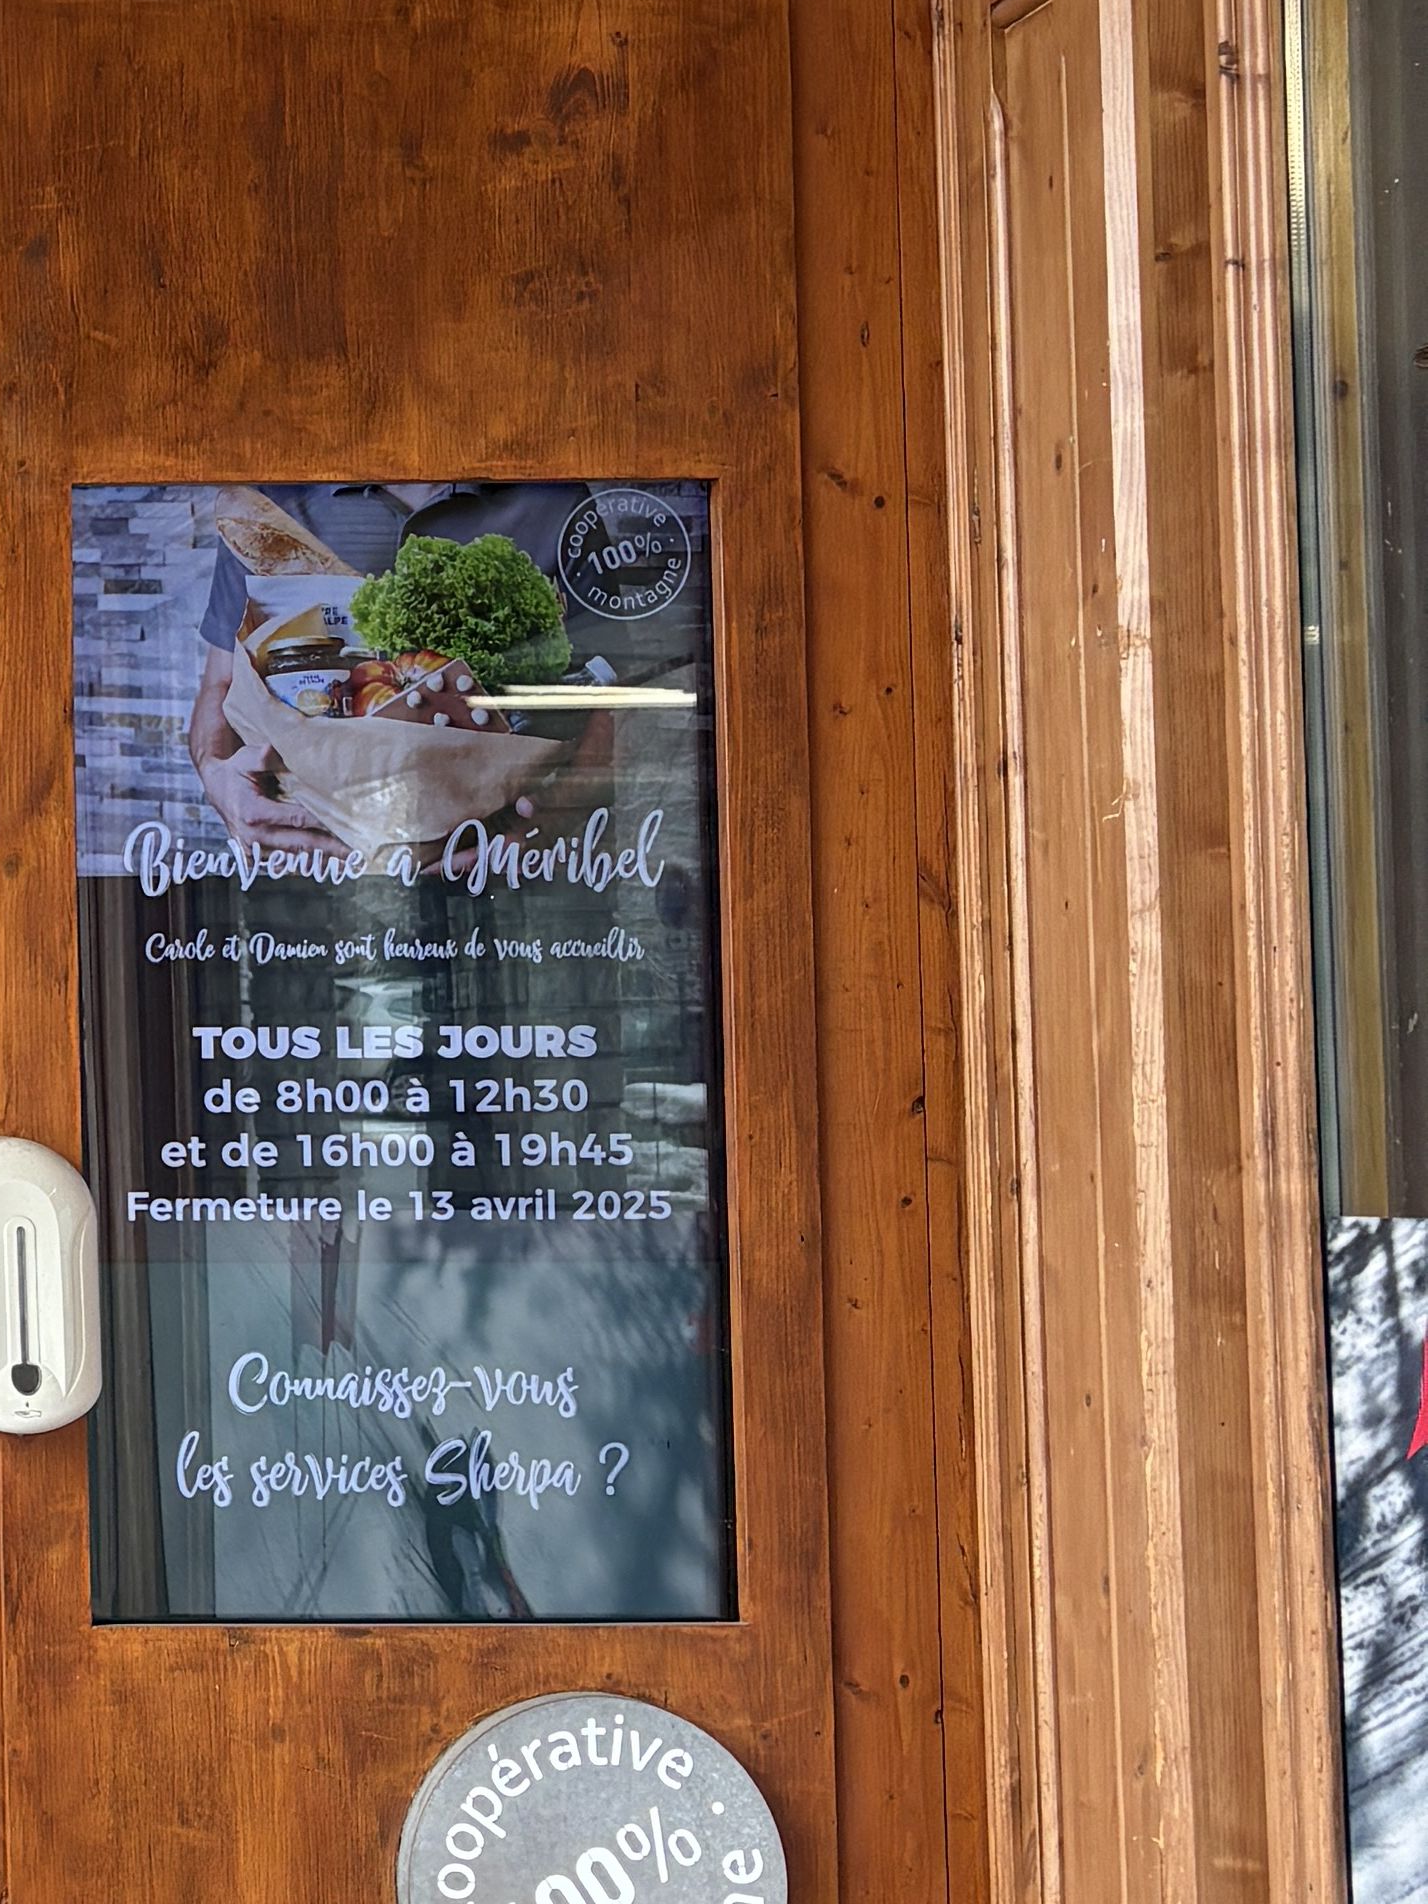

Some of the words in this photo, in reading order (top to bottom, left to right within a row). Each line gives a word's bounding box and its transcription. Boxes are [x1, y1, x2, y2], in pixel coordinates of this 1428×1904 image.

[587, 531, 663, 575] 100%
[587, 557, 682, 611] montagne
[440, 807, 666, 897] Méribel
[145, 927, 216, 963] Carole
[221, 935, 242, 962] et
[249, 931, 329, 965] Damien
[334, 933, 377, 965] sont
[383, 927, 458, 961] heureux
[463, 926, 487, 961] de
[493, 937, 543, 964] vous
[549, 926, 645, 963] accueillir
[192, 1026, 321, 1060] TOUS
[335, 1026, 424, 1060] LES
[437, 1025, 598, 1060] JOURS
[203, 1079, 261, 1114] de
[275, 1079, 390, 1114] 8h00
[405, 1078, 431, 1114] à
[448, 1079, 590, 1113] 12h30
[160, 1138, 206, 1170] et
[221, 1133, 279, 1170] de
[296, 1133, 436, 1169] 16h00
[451, 1132, 477, 1168] à
[493, 1132, 635, 1167] 19h45
[126, 1191, 343, 1223] Fermeture
[357, 1189, 394, 1223] le
[408, 1190, 456, 1222] 13
[470, 1188, 557, 1222] avril
[571, 1189, 672, 1221] 2025
[227, 1351, 580, 1421] Connaissez-vous
[175, 1429, 234, 1508] les
[249, 1450, 408, 1508] services
[423, 1429, 582, 1510] Sherpa
[598, 1441, 631, 1496] ?
